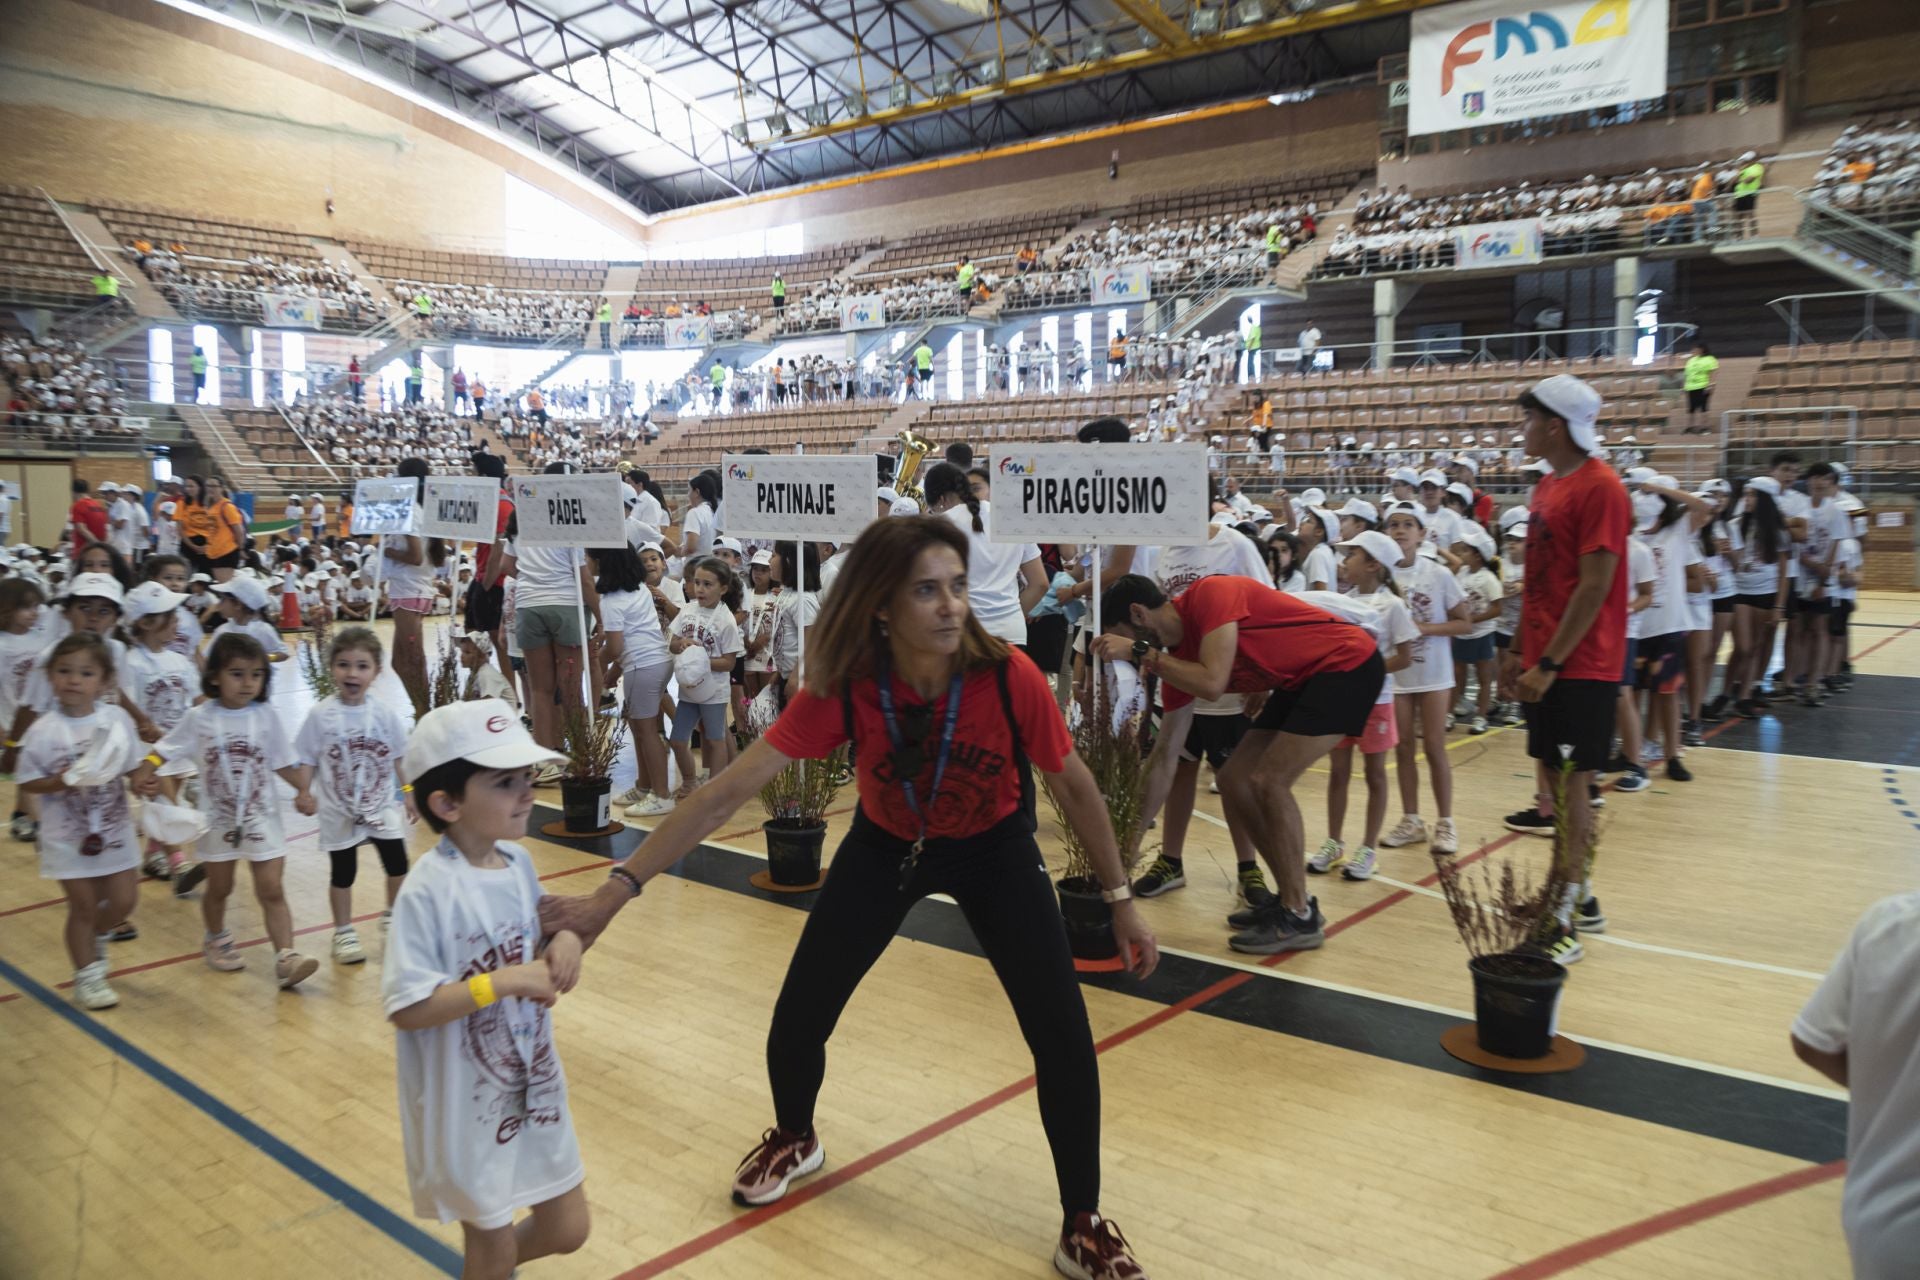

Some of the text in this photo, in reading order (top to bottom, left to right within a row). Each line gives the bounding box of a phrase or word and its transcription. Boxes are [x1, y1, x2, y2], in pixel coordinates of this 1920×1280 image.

[548, 492, 587, 526] PÁDEL
[757, 482, 836, 516] PATINAJE
[1022, 470, 1167, 515] PIRAGÜISMO
